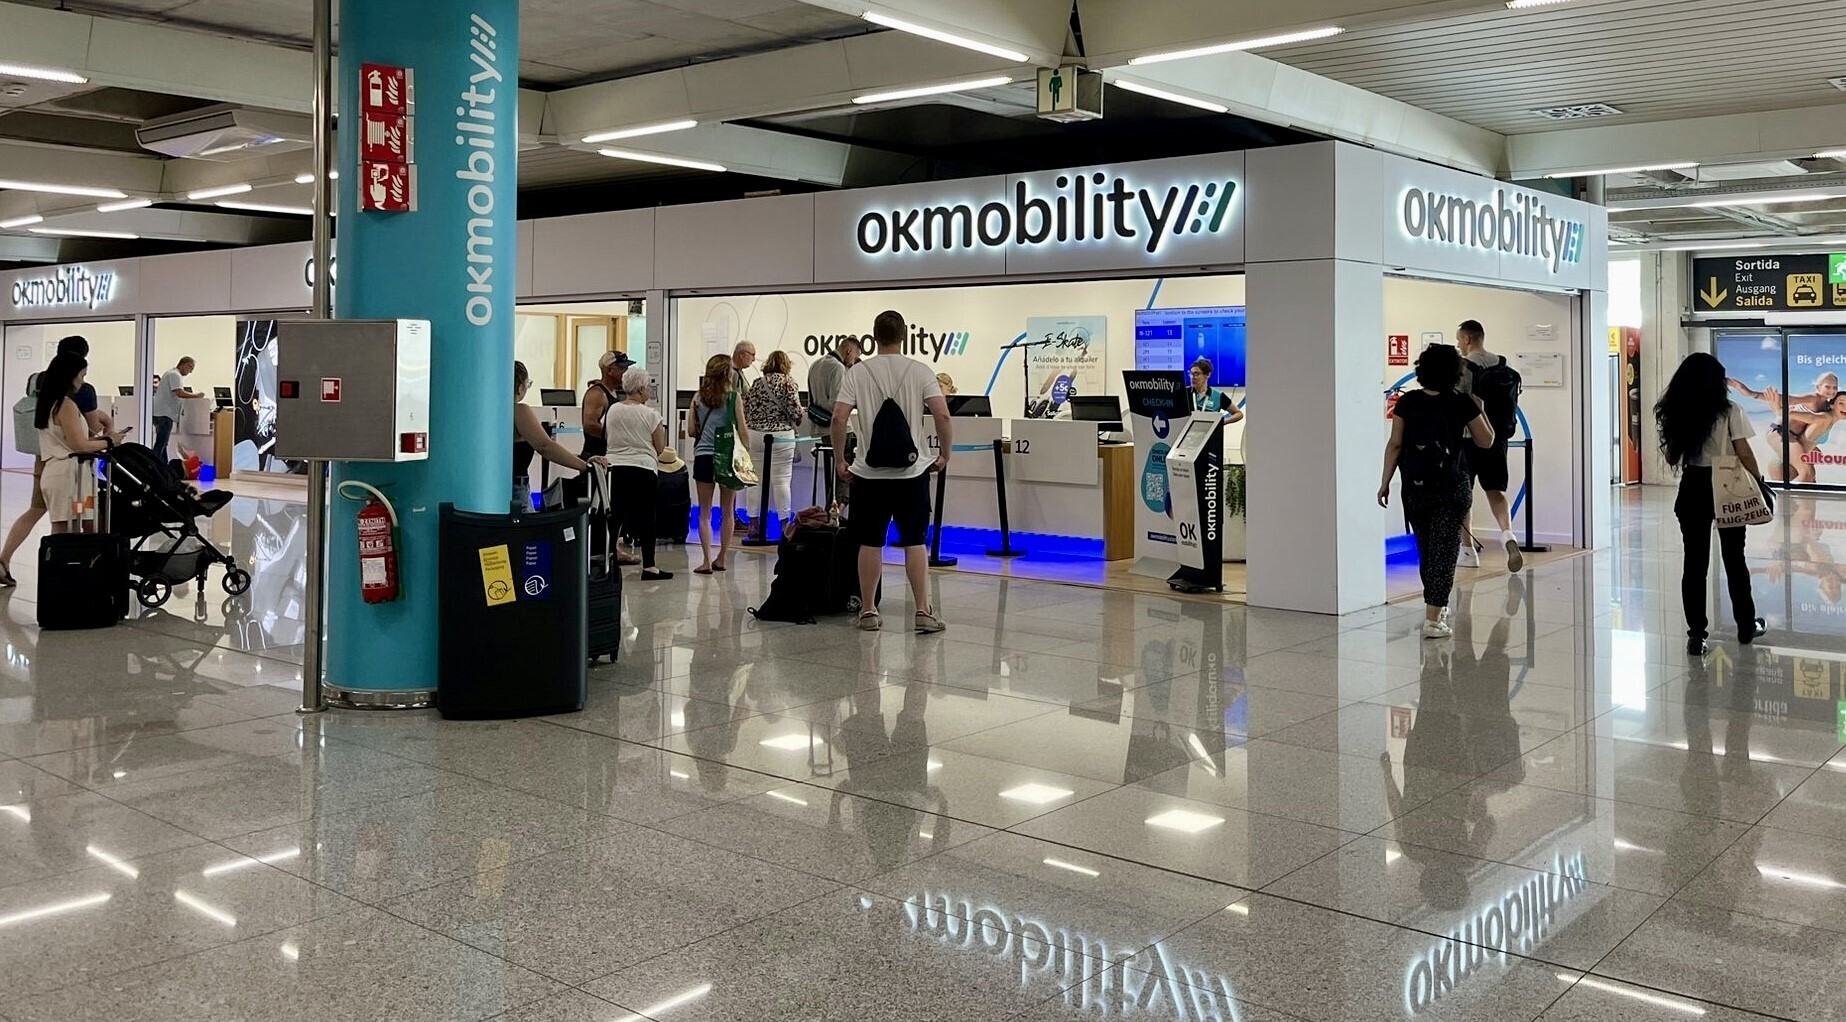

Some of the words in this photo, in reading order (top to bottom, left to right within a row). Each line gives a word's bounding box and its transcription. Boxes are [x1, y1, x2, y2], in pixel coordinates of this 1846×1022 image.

[1735, 259, 1780, 271] Sortida
[1735, 273, 1753, 282] Exit
[1794, 275, 1816, 283] TAXI
[1735, 284, 1777, 295] Ausgang
[1736, 296, 1773, 307] Salida
[1797, 354, 1813, 364] Bis
[1142, 397, 1174, 407] CHECK-IN
[1015, 439, 1030, 454] 12
[1722, 502, 1742, 514] FÜR
[1743, 497, 1760, 510] IHR
[1716, 507, 1770, 524] FLUG-ZEUG
[1180, 521, 1198, 541] OK
